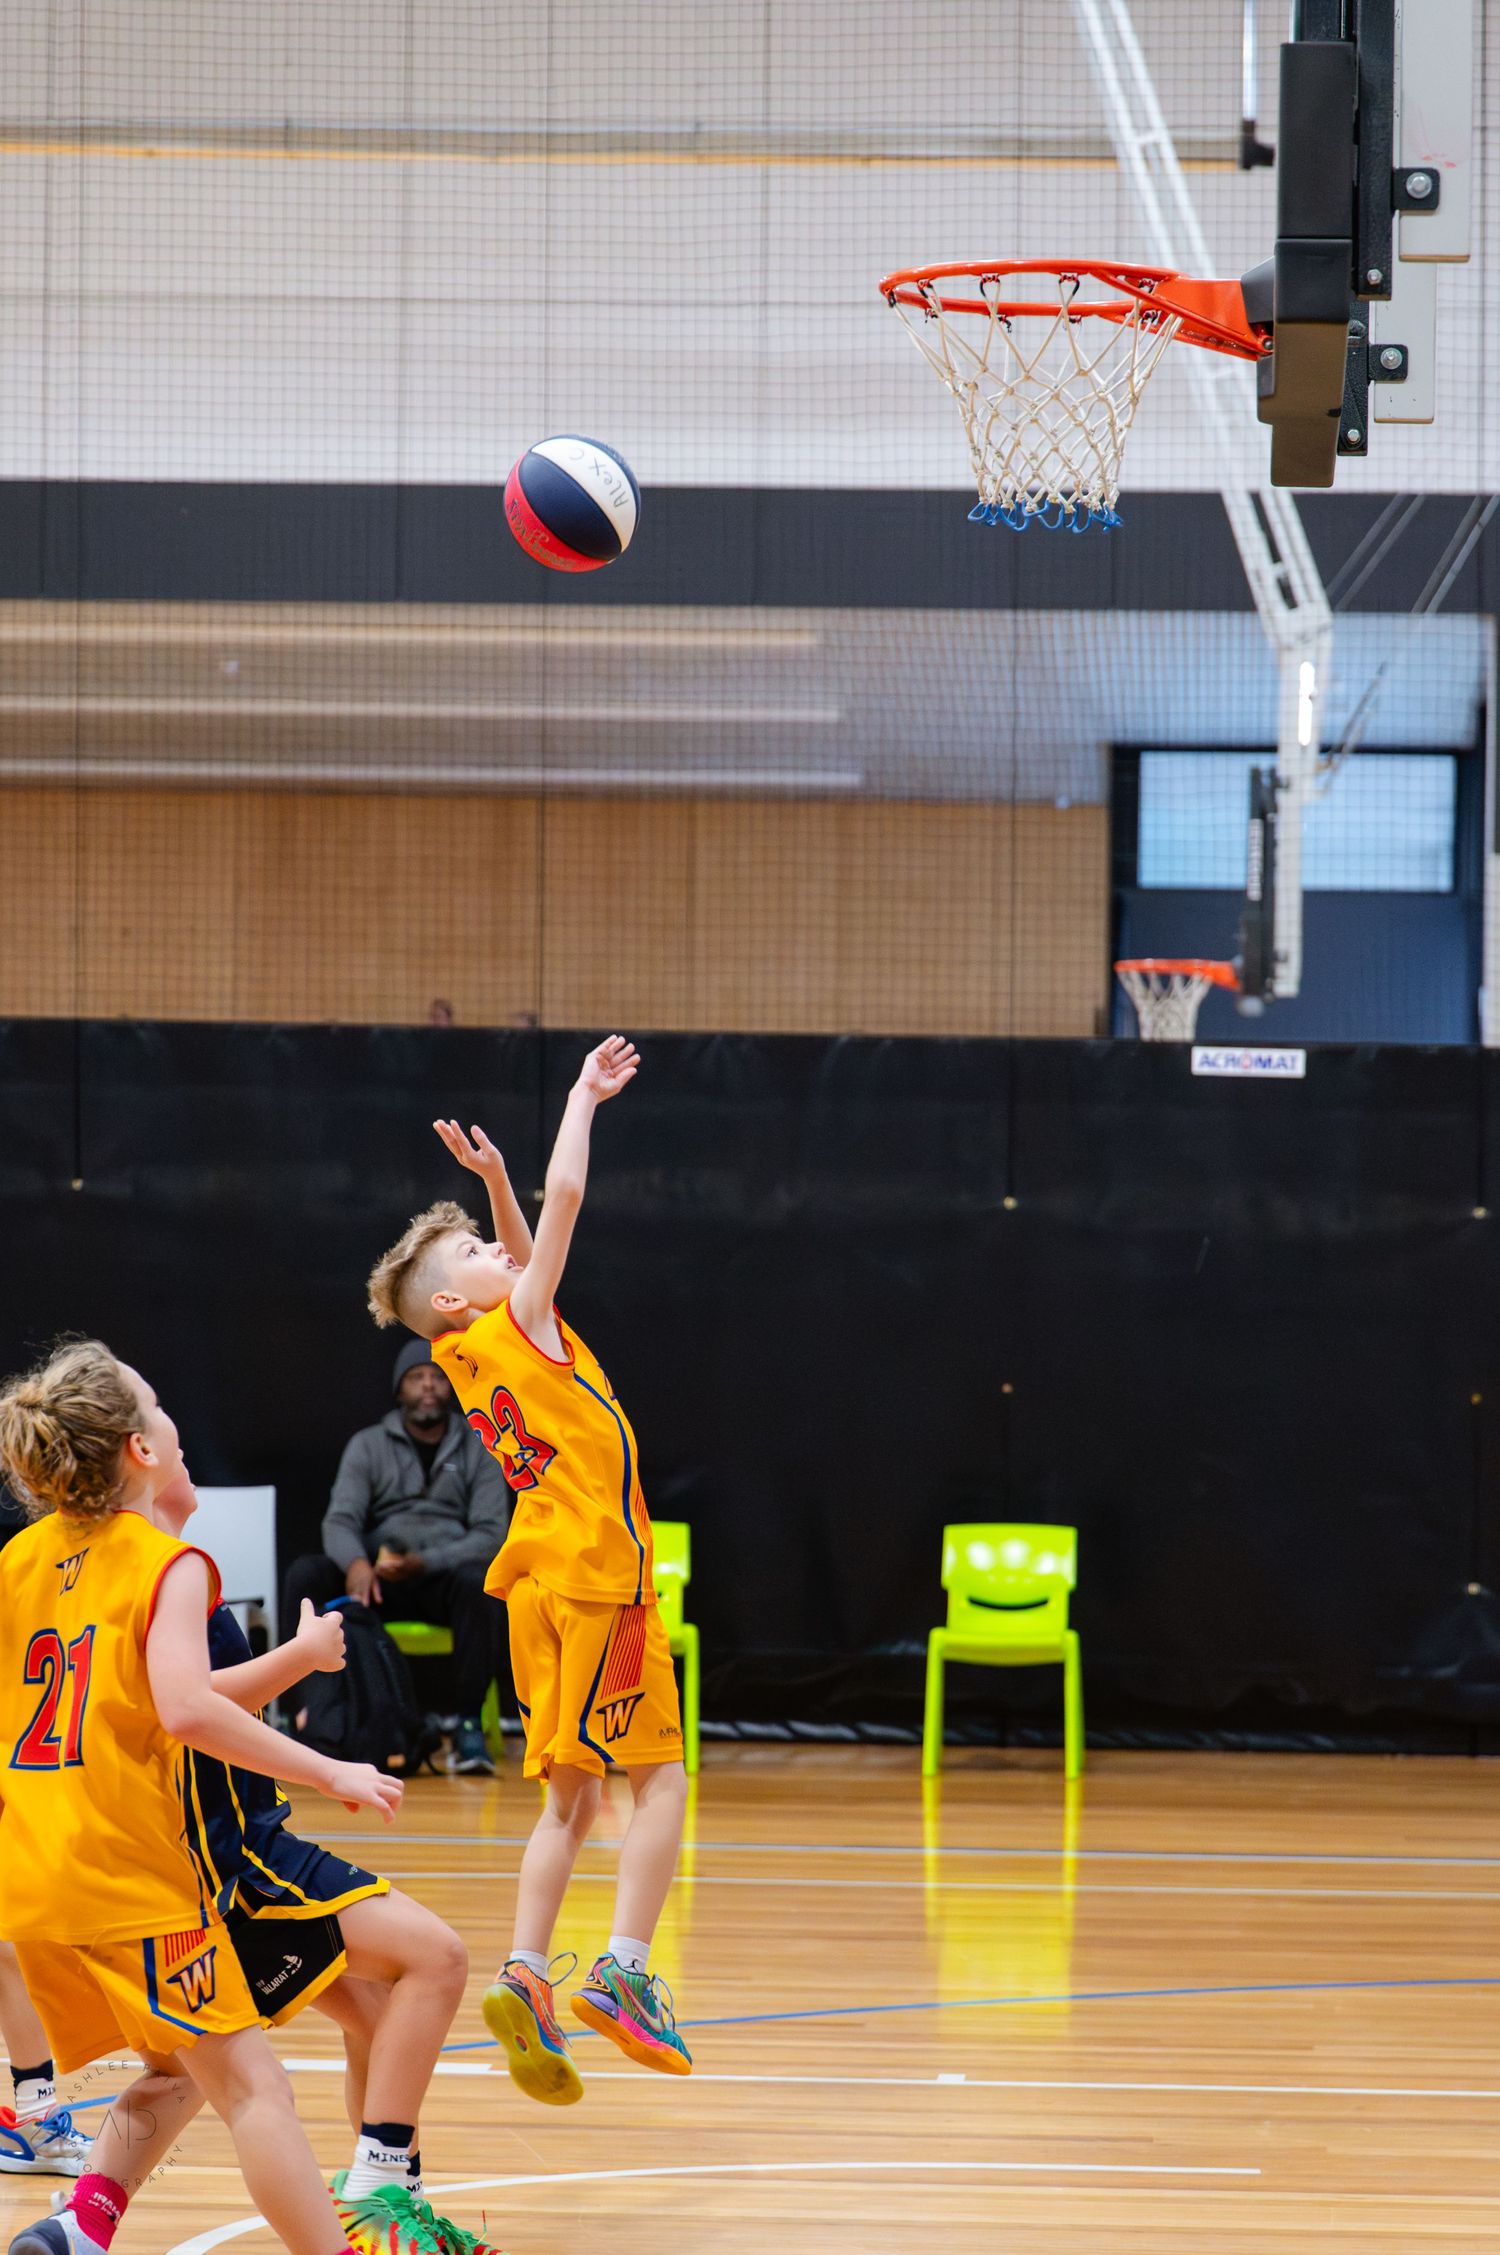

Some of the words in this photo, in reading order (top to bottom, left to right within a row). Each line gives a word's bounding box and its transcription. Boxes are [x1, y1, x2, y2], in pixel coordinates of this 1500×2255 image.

[1198, 1052, 1298, 1070] ACROMAT
[56, 1546, 90, 1596] W
[8, 1623, 97, 1771] 21
[595, 1691, 646, 1744] W
[166, 1945, 217, 2013] W
